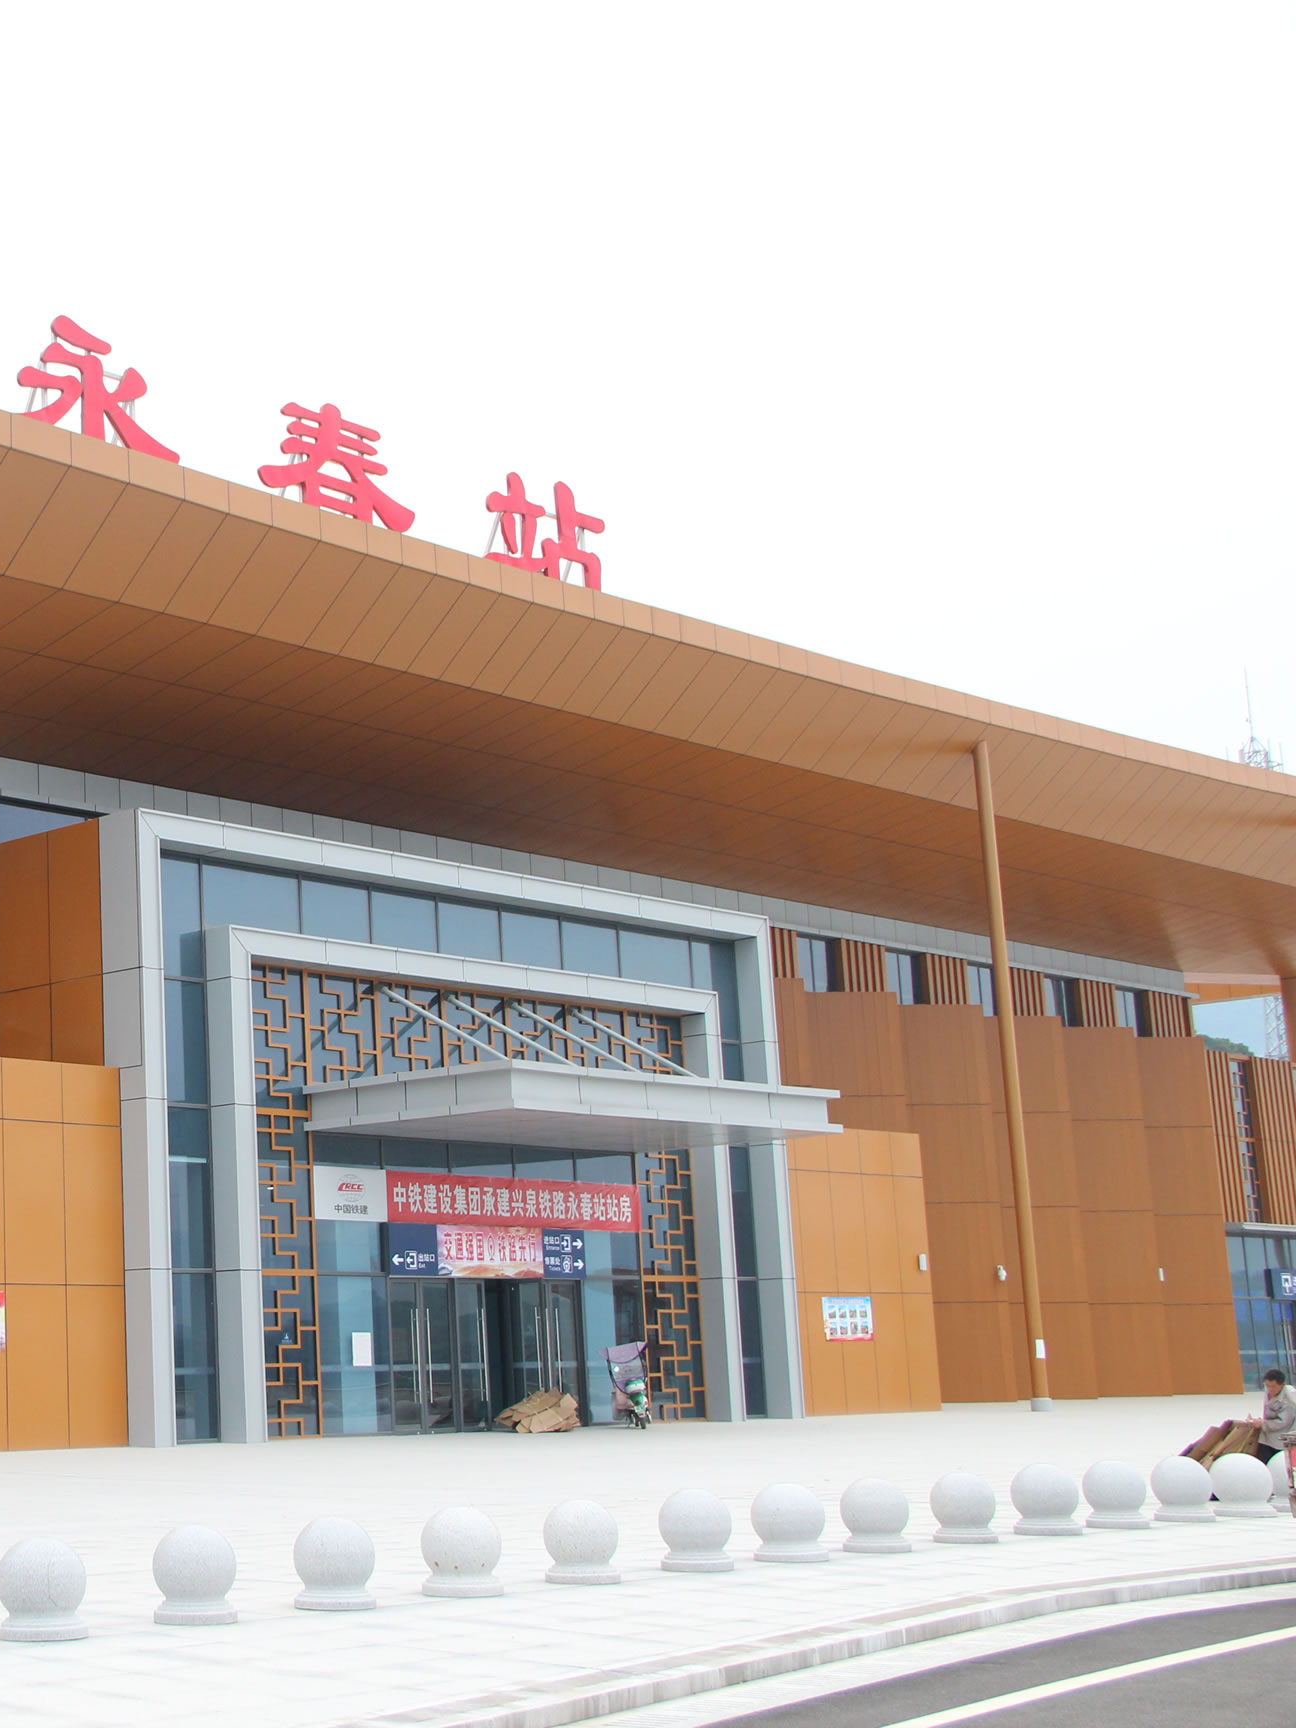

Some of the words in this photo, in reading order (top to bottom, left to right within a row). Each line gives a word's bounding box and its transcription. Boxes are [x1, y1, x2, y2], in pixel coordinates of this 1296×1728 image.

[17, 315, 605, 592] 永春站
[334, 1203, 368, 1215] 中国铁建
[393, 1181, 632, 1223] 中铁建设集团承建兴泉铁路永春站站房
[444, 1231, 485, 1261] 交通强国
[498, 1232, 536, 1262] 铁路先行
[544, 1236, 559, 1245] 进站口
[418, 1253, 436, 1262] 出站口
